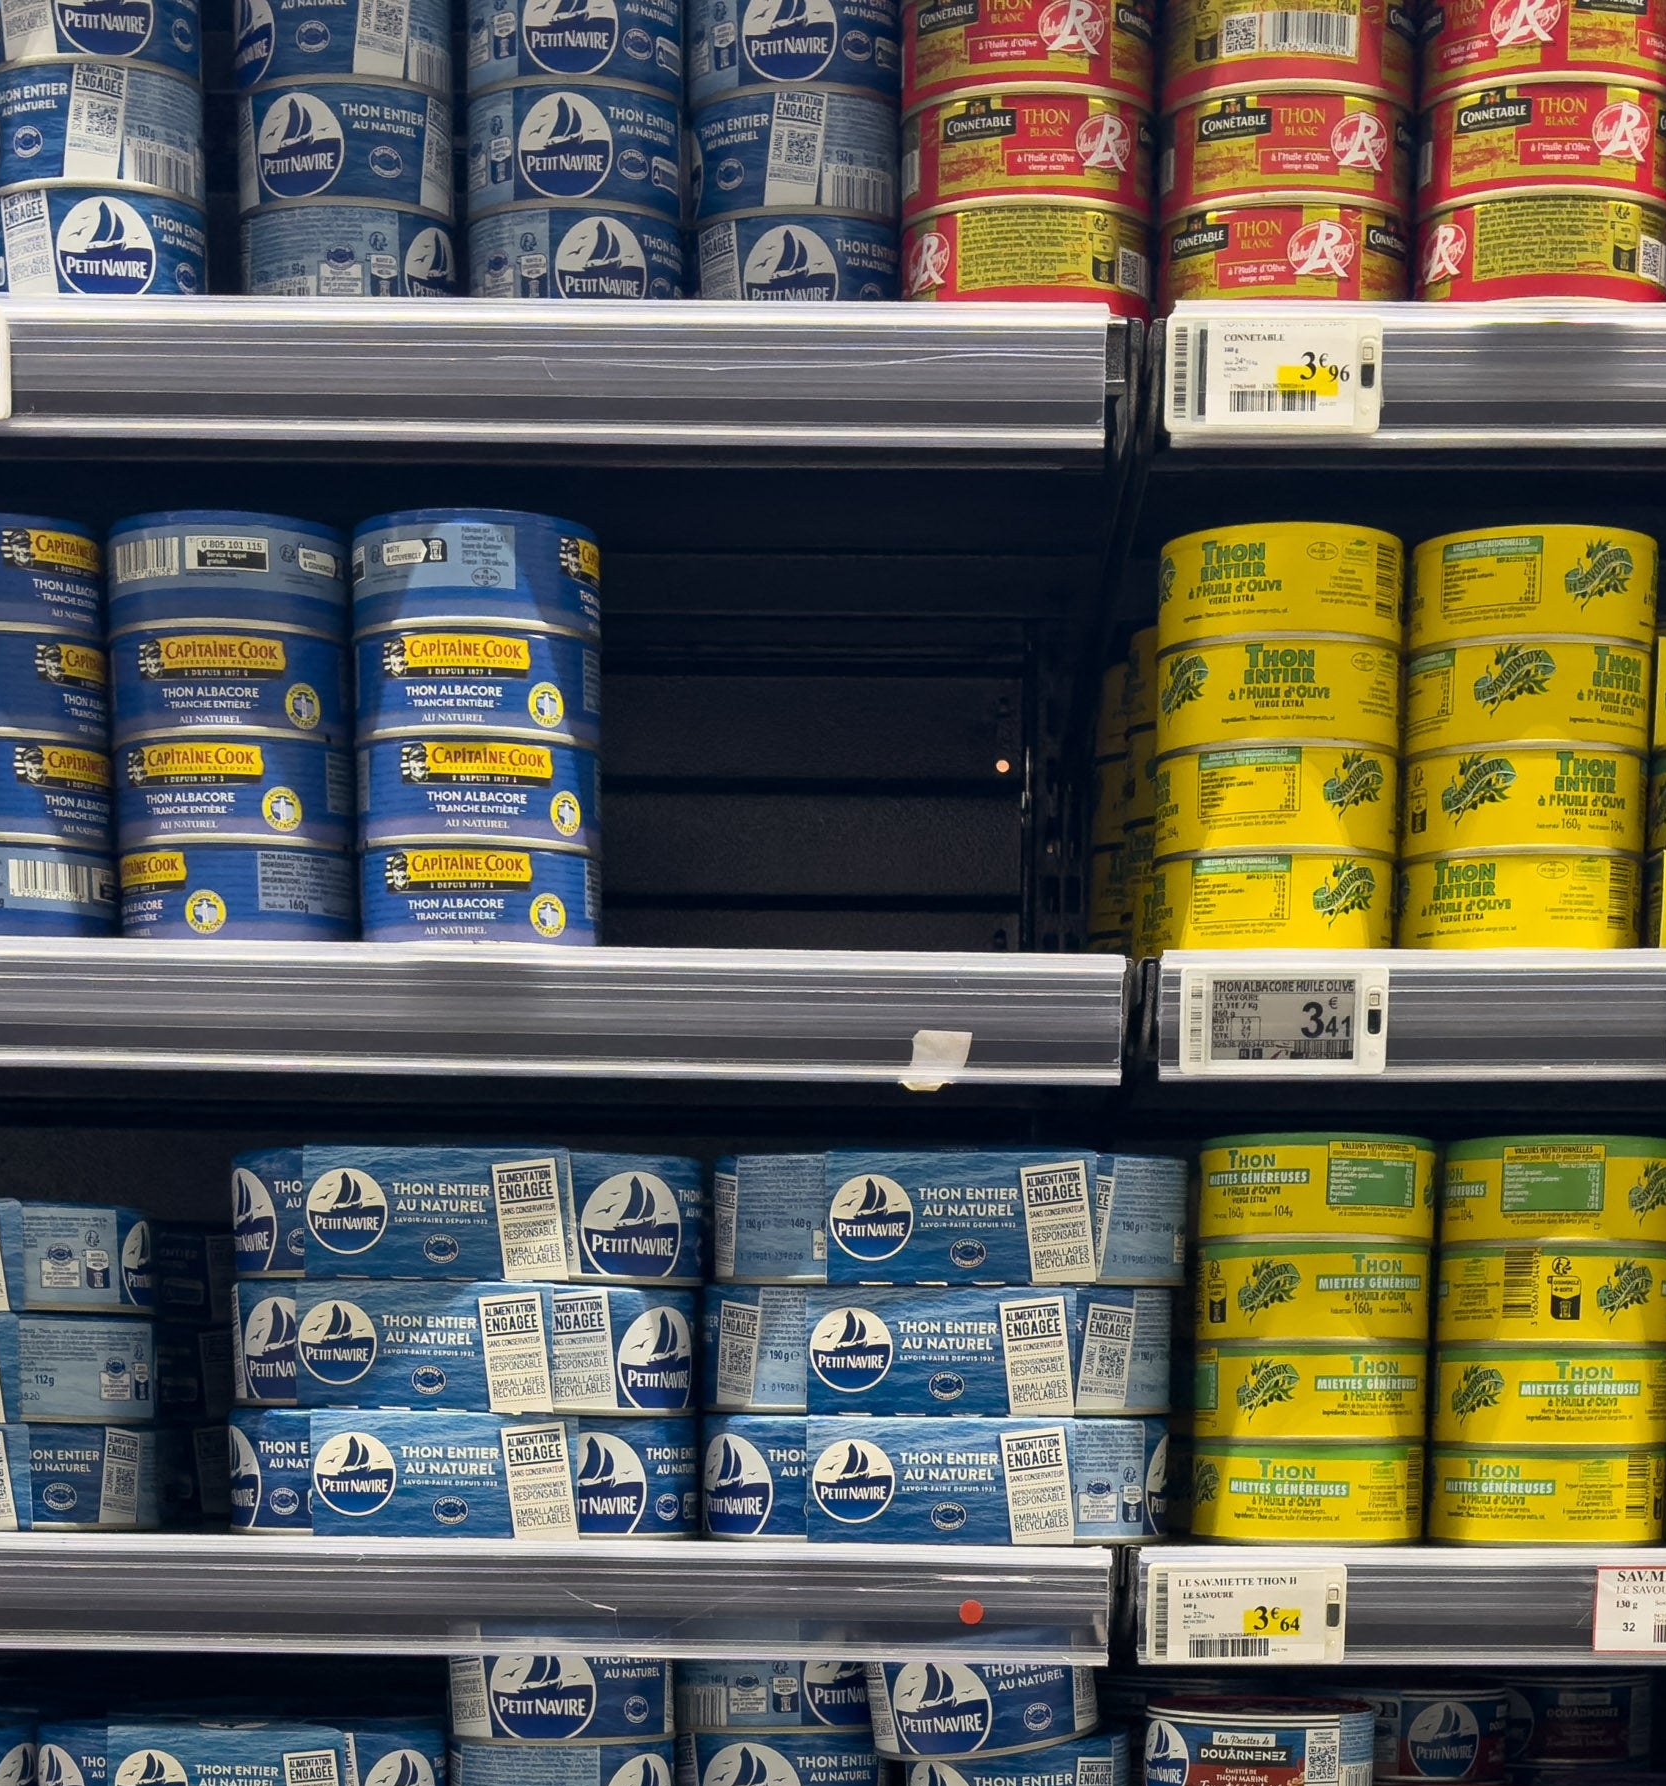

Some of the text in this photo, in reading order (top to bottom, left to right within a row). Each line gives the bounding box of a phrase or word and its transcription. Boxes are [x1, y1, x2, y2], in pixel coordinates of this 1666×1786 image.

[1538, 97, 1588, 113] THON
[340, 103, 424, 126] THON ENTIER
[369, 124, 416, 138] NATUREL
[1245, 644, 1315, 667] THON
[1245, 668, 1315, 683] ENTIER
[409, 1461, 426, 1475] AU
